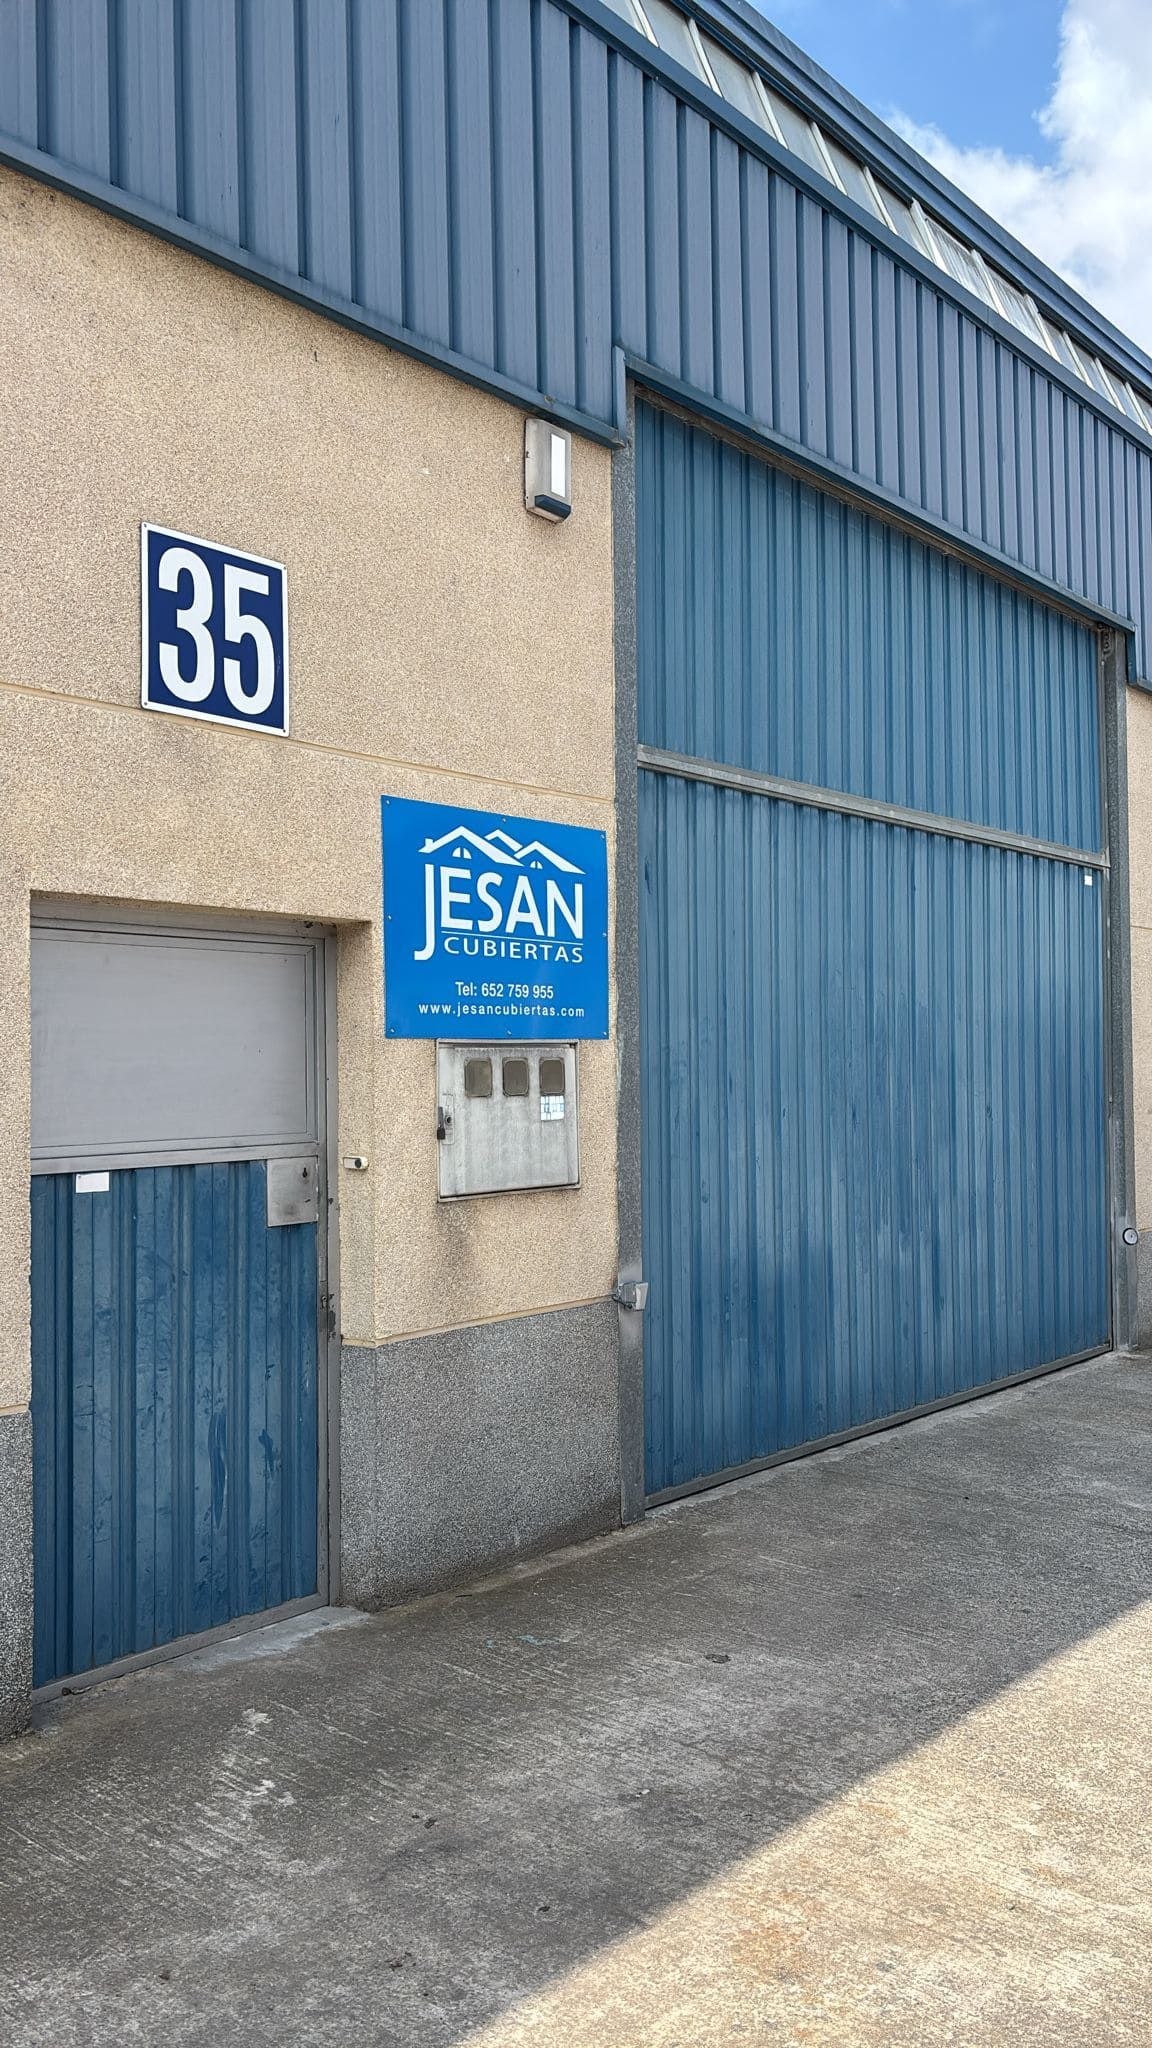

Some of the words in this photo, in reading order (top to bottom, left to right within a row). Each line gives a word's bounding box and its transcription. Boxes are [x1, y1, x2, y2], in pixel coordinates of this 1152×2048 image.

[158, 547, 275, 715] 35
[414, 863, 583, 961] JESAN
[444, 936, 584, 963] CUBIERTAS
[455, 981, 478, 997] Tel:
[481, 983, 504, 998] 652
[507, 984, 529, 999] 759
[533, 985, 554, 999] 955
[418, 1002, 585, 1017] www.jesancubiertas.com
